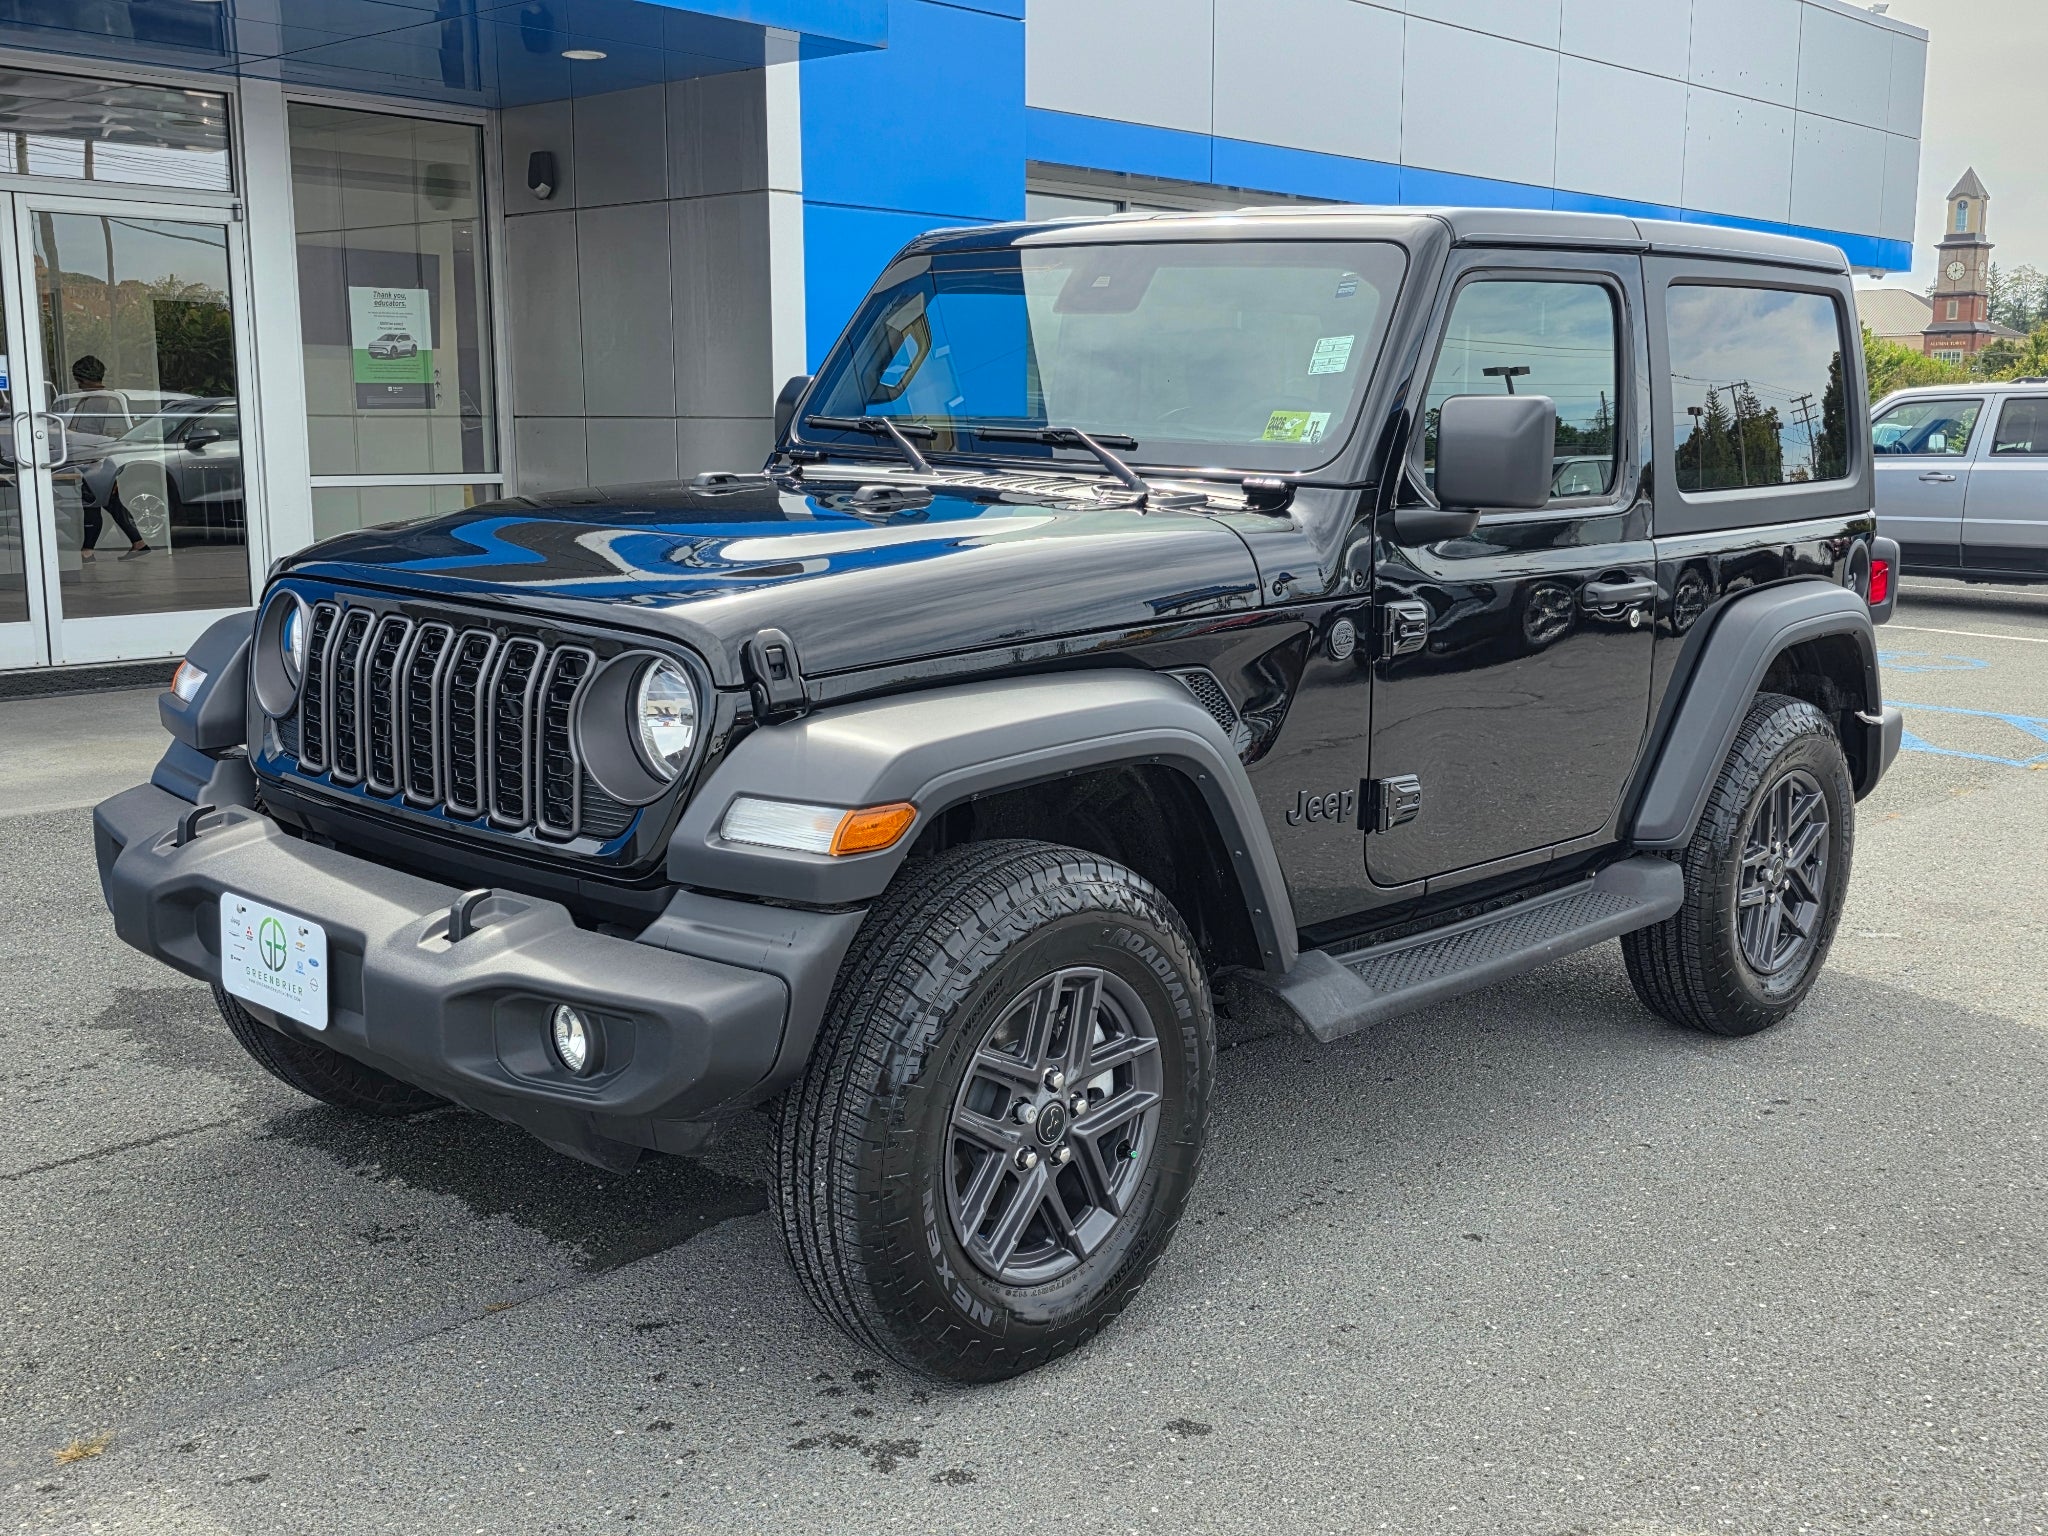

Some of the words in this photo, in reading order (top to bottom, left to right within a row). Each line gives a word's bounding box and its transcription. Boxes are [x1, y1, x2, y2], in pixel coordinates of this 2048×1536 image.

[373, 291, 391, 299] Thank
[1286, 789, 1354, 826] Jeep
[246, 966, 303, 996] GREENBRIER
[1109, 927, 1193, 1019] ROADIAN
[962, 976, 1005, 1036] Weather
[922, 1187, 994, 1328] NEXEN
